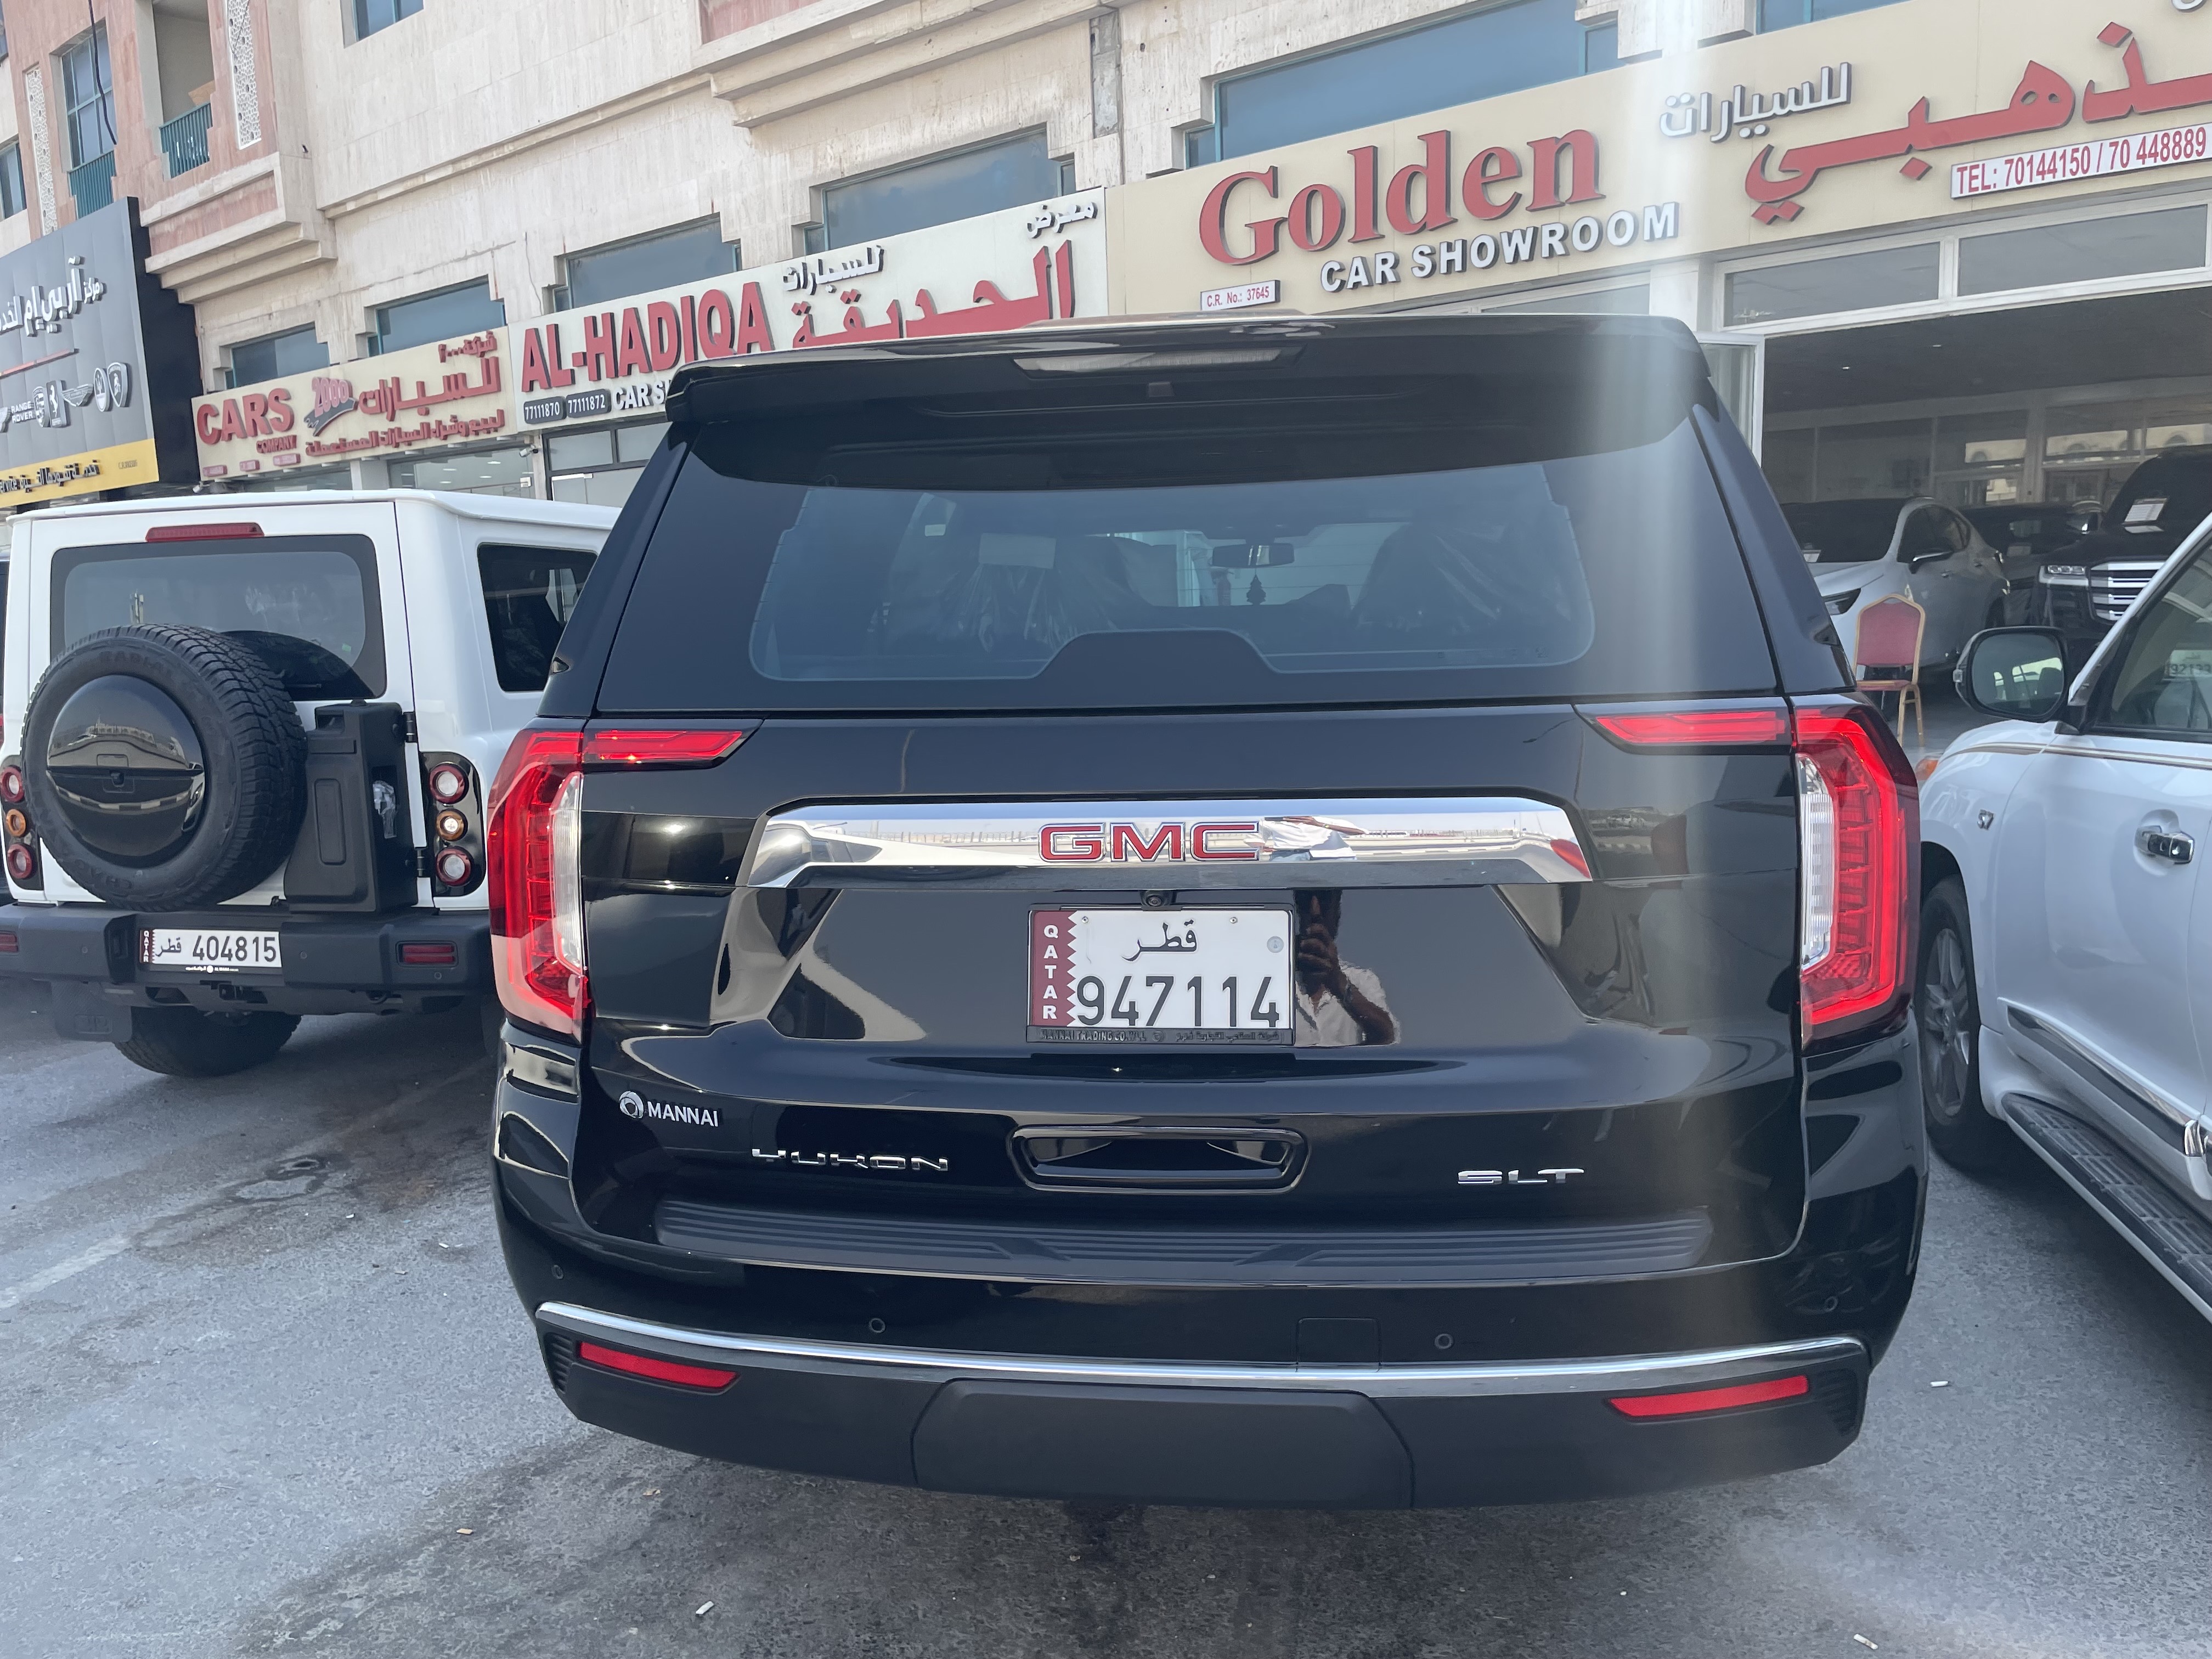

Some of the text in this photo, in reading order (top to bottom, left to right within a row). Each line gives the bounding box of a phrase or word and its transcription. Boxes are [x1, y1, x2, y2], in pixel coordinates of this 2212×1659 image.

[1660, 62, 1852, 143] للسيارات
[1745, 21, 2212, 225] ذهبي
[1956, 163, 1997, 194] TEL:
[2004, 145, 2091, 187] 70144150
[2109, 139, 2131, 171] 70
[2136, 127, 2206, 166] 448889
[1199, 128, 1606, 266] Golden
[1026, 201, 1098, 239] معرض
[1321, 201, 1680, 293] CAR SHOWROOM
[83, 277, 105, 304] مركز
[792, 240, 1075, 348] الحديقة
[1207, 294, 1223, 307] C.R.
[1246, 286, 1269, 301] 37645
[522, 281, 775, 393] AL-HADIQA
[11, 401, 34, 414] RANGE
[312, 376, 353, 417] 2000
[524, 394, 606, 420] 77111870 77111872
[612, 382, 652, 410] CAR
[12, 411, 36, 424] ROVER
[197, 388, 295, 445] CARS
[256, 435, 297, 453] COMPANY
[1038, 822, 1259, 863] GMC
[155, 936, 182, 957] قطر
[193, 935, 276, 962] 404815
[1121, 919, 1198, 962] قطر
[1043, 924, 1059, 1020] QATAR
[1076, 975, 1280, 1028] 947114
[1076, 1029, 1113, 1041] TRADING
[647, 1101, 719, 1127] MANNAI
[752, 1148, 949, 1171] YUKON
[1458, 1168, 1584, 1185] SLT
